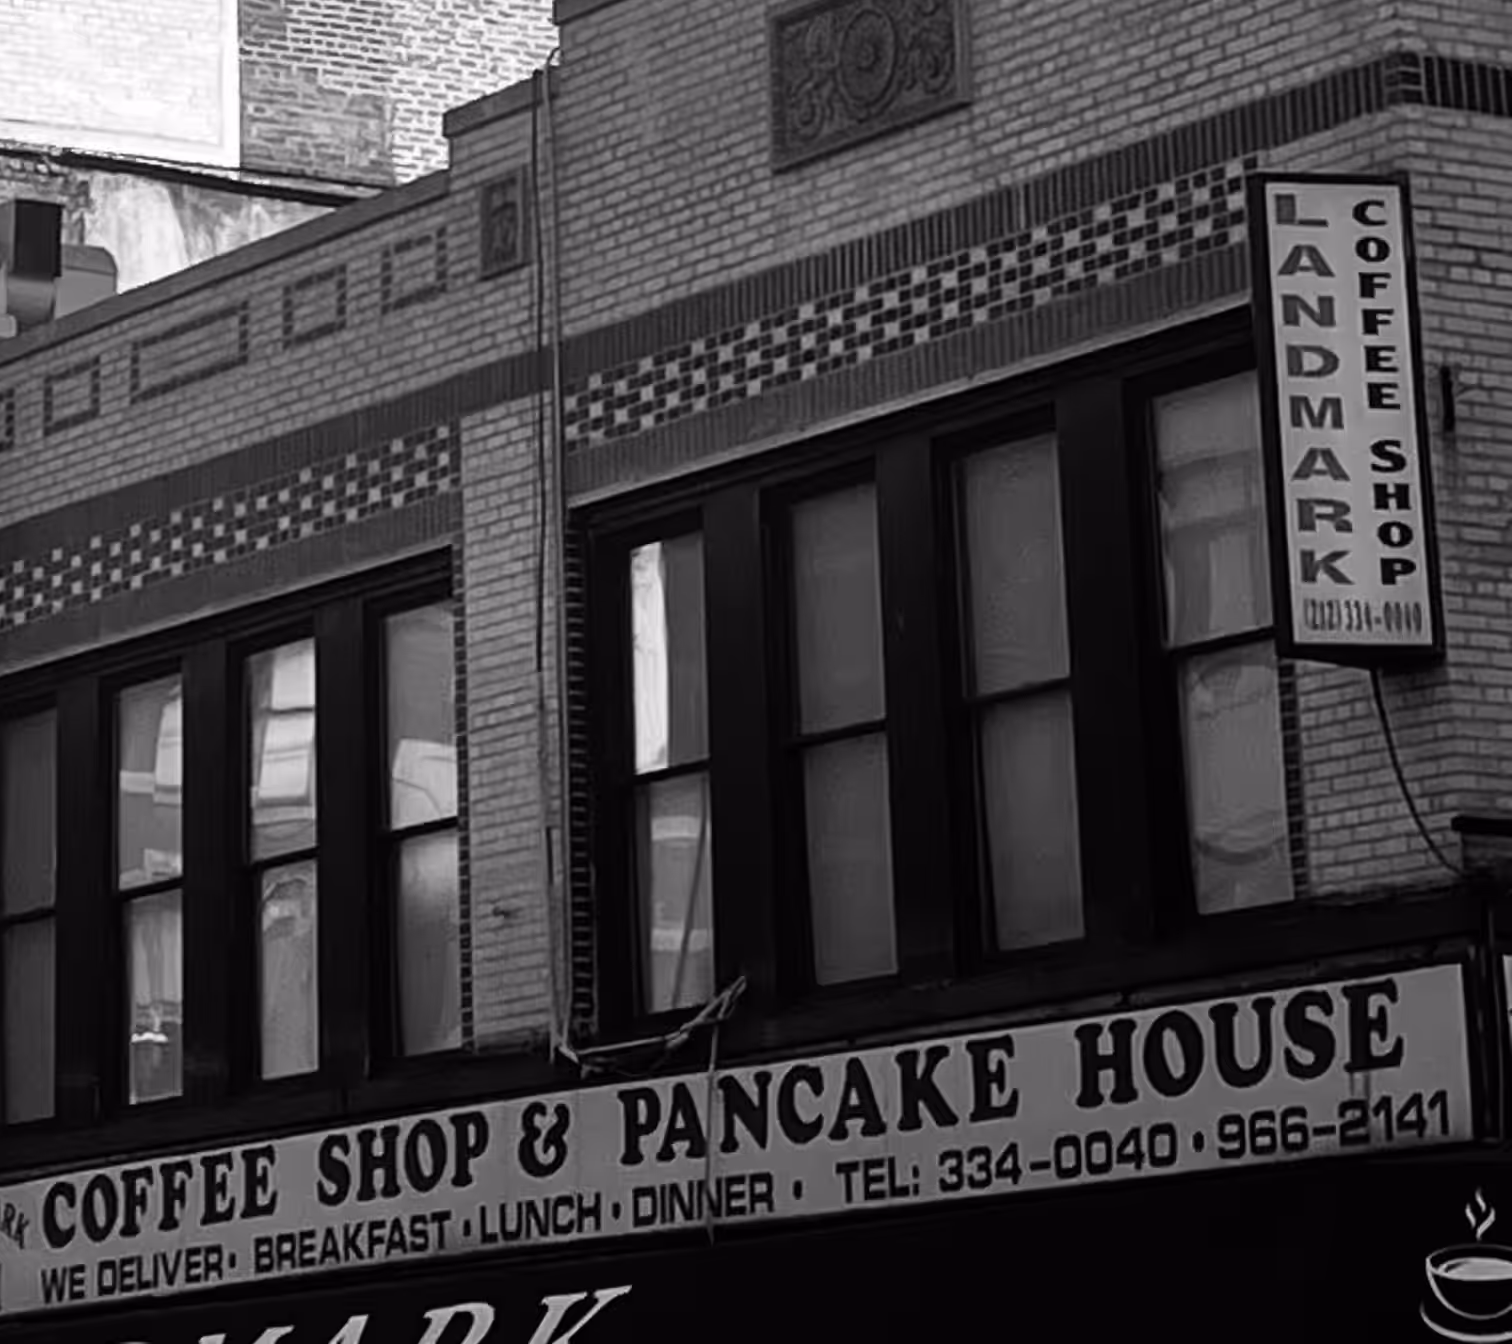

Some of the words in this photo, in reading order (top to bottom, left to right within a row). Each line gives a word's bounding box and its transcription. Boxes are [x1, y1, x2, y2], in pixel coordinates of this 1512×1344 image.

[1273, 193, 1354, 585] LANDMARK
[1351, 199, 1401, 411] COFFEE
[1370, 439, 1417, 586] SHOP
[40, 1263, 86, 1305] WE
[97, 1243, 224, 1298] DELIVER
[253, 1208, 452, 1275] BREAKFAST
[478, 1191, 602, 1246] LUNCH
[631, 1171, 775, 1229] DINNER
[835, 1155, 922, 1204] TEL:
[938, 1121, 1178, 1193] 334-0040
[1217, 1088, 1453, 1160] 966-2141
[42, 1144, 278, 1249] COFFEE
[316, 1110, 490, 1207] SHOP
[517, 1101, 571, 1178] &
[616, 1033, 1020, 1166] PANCAKE
[1073, 978, 1405, 1109] HOUSE
